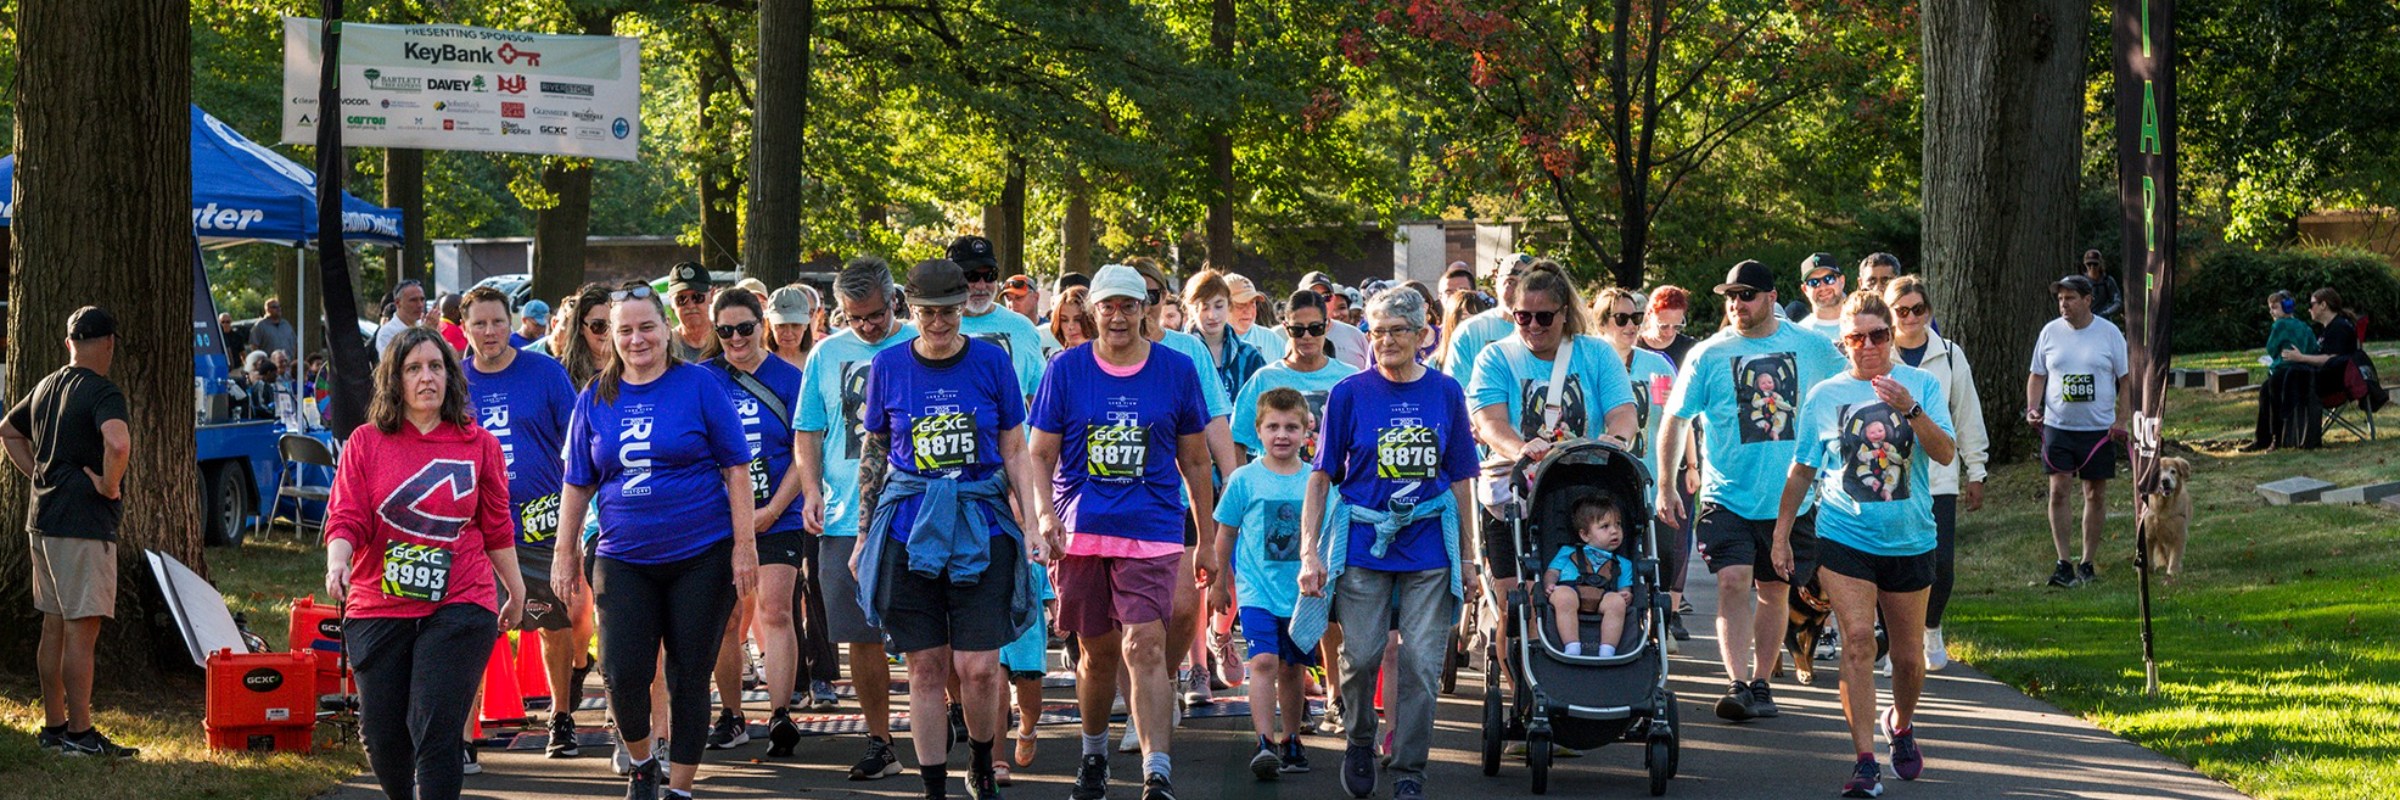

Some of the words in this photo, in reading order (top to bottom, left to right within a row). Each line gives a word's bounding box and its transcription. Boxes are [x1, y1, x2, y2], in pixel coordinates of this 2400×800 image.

[405, 27, 477, 39] PRESENTING
[480, 31, 534, 43] SPONSOR
[404, 42, 494, 64] KeyBank
[427, 79, 471, 91] DAVEY
[542, 83, 593, 94] RIVERSTONE
[346, 116, 386, 125] carron
[540, 125, 568, 136] GCXC
[192, 202, 264, 230] ter
[2063, 384, 2093, 396] 8986
[918, 418, 968, 432] GCXC
[1094, 430, 1142, 442] GCXC
[1384, 432, 1432, 443] GCXC
[917, 432, 975, 457] 8875
[619, 417, 653, 496] RUN
[1091, 445, 1146, 465] 8877
[1380, 446, 1437, 466] 8876
[526, 496, 560, 515] GCXC
[526, 510, 560, 534] 876
[392, 546, 443, 565] GCXC
[385, 562, 446, 590] 8993
[321, 624, 341, 632] GCX
[246, 675, 276, 684] GCXC
